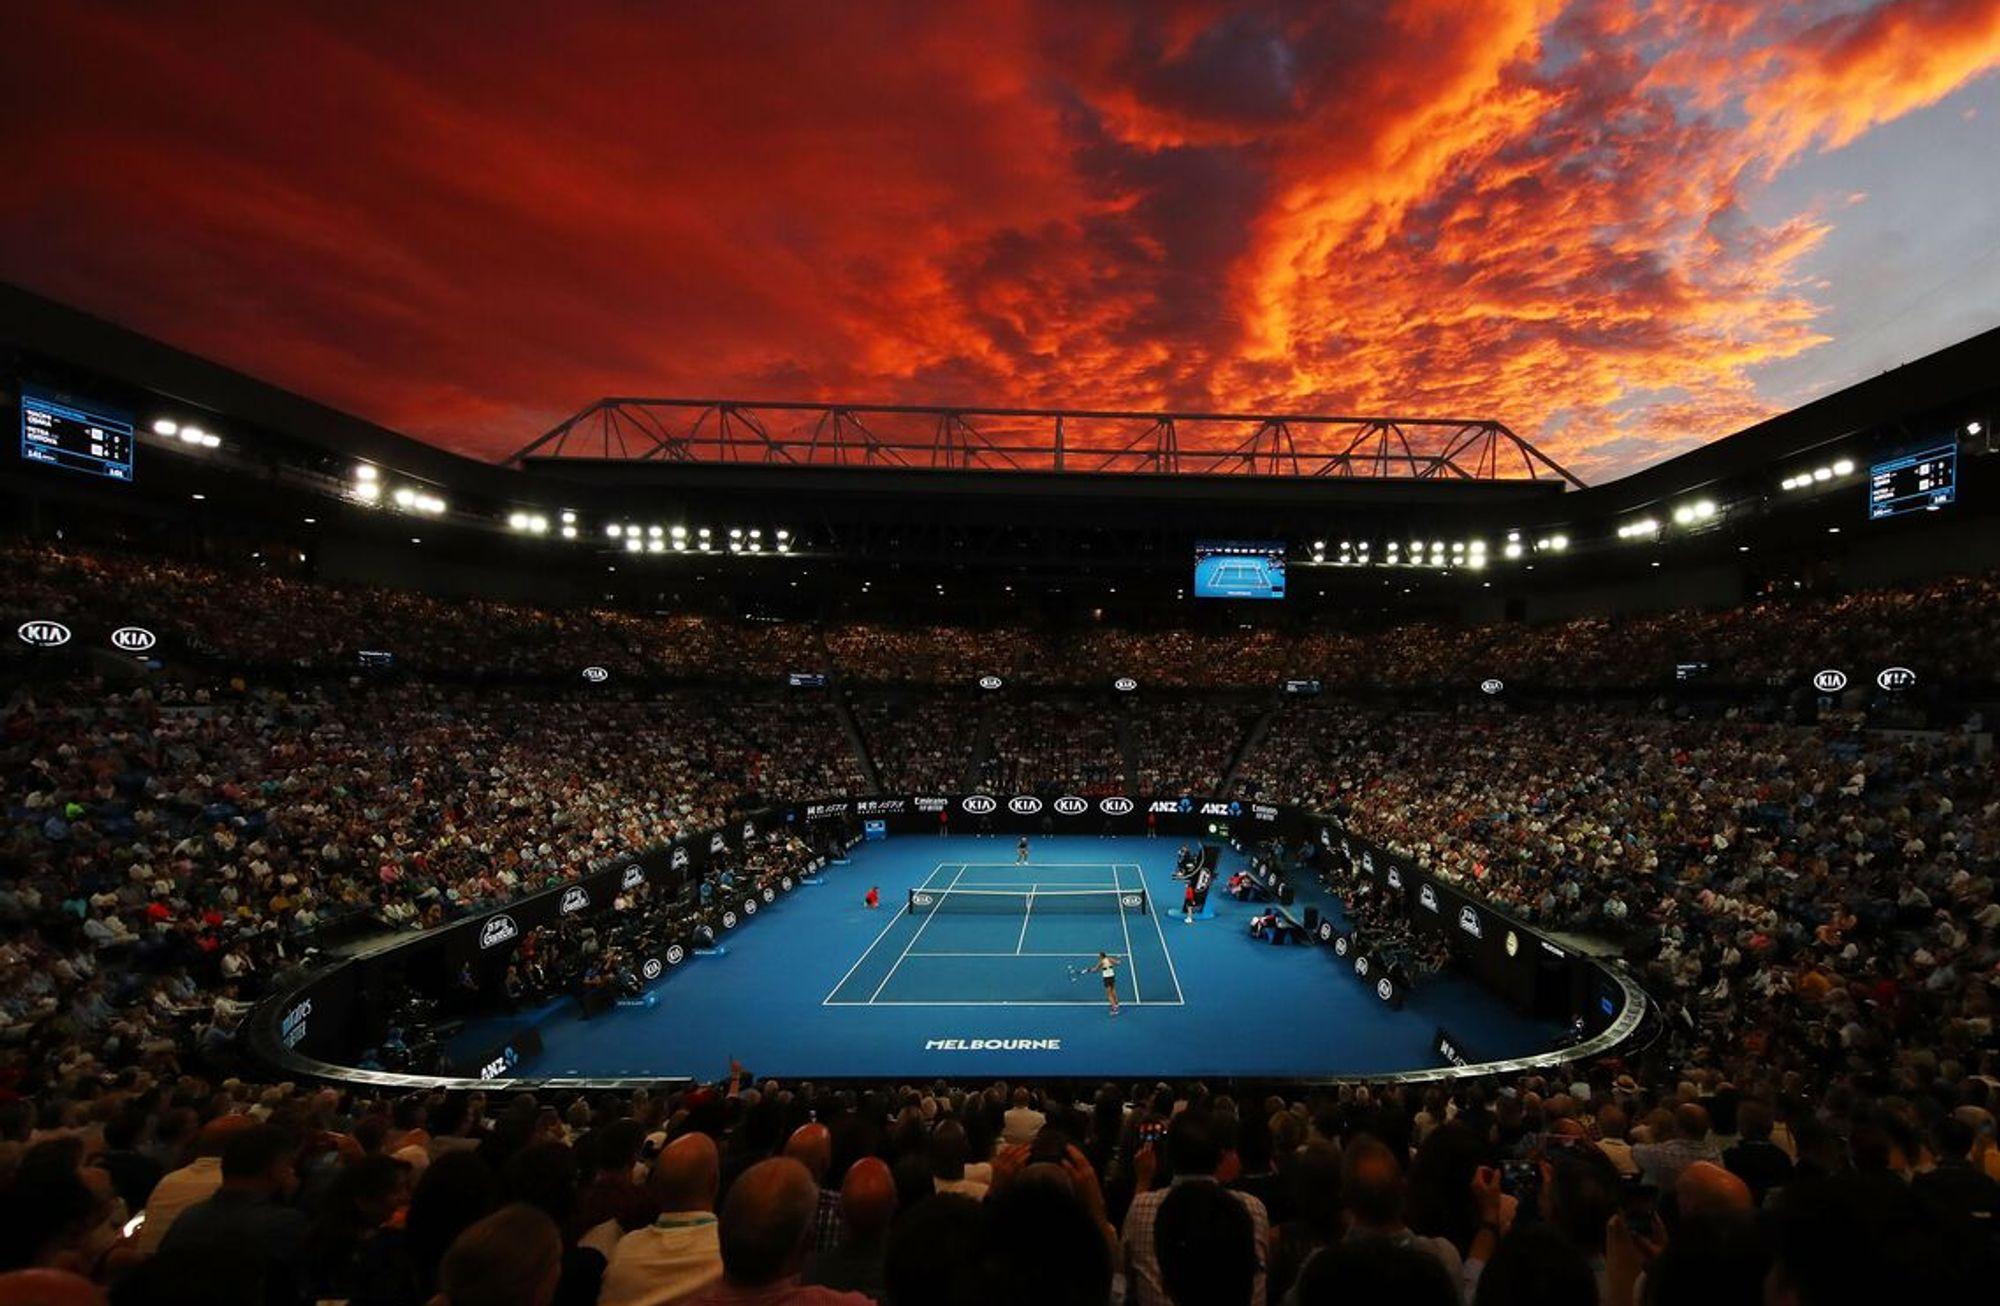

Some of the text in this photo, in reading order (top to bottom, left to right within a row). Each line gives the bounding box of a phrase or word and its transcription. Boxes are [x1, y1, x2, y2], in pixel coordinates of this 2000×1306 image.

[1148, 801, 1178, 812] ANZ
[1200, 803, 1228, 815] ANZ
[925, 1039, 1061, 1050] MELBOURNE
[481, 1057, 507, 1080] ANZ
